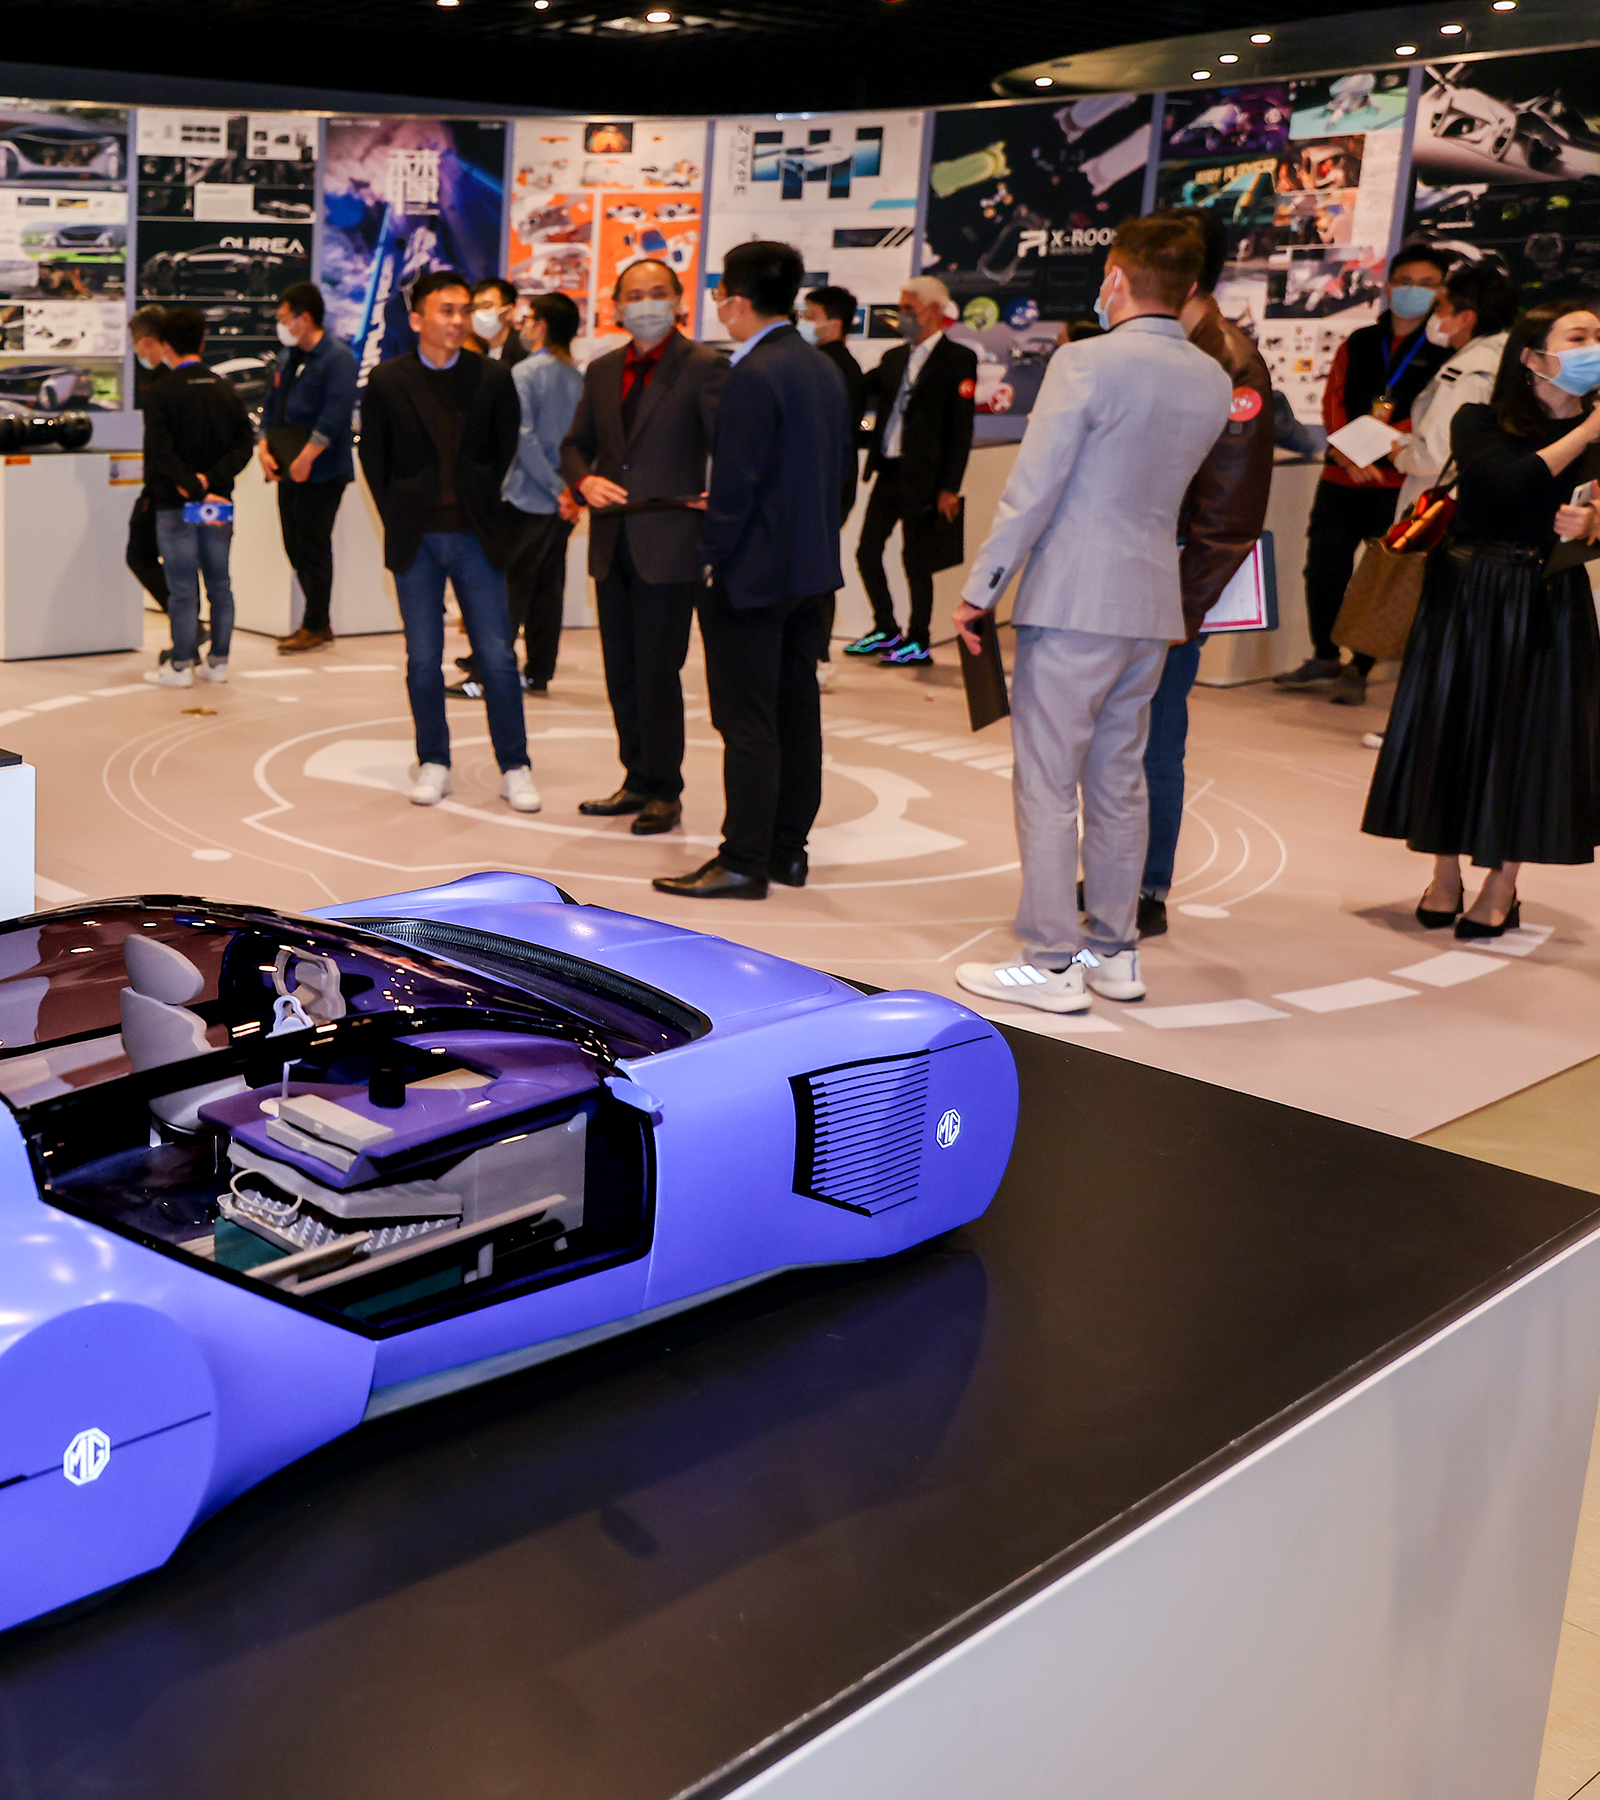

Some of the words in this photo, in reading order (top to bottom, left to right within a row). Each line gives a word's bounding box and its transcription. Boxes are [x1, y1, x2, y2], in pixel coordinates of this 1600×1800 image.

[1051, 228, 1117, 247] X-ROO
[937, 1110, 960, 1147] MG
[66, 1431, 108, 1483] MG
